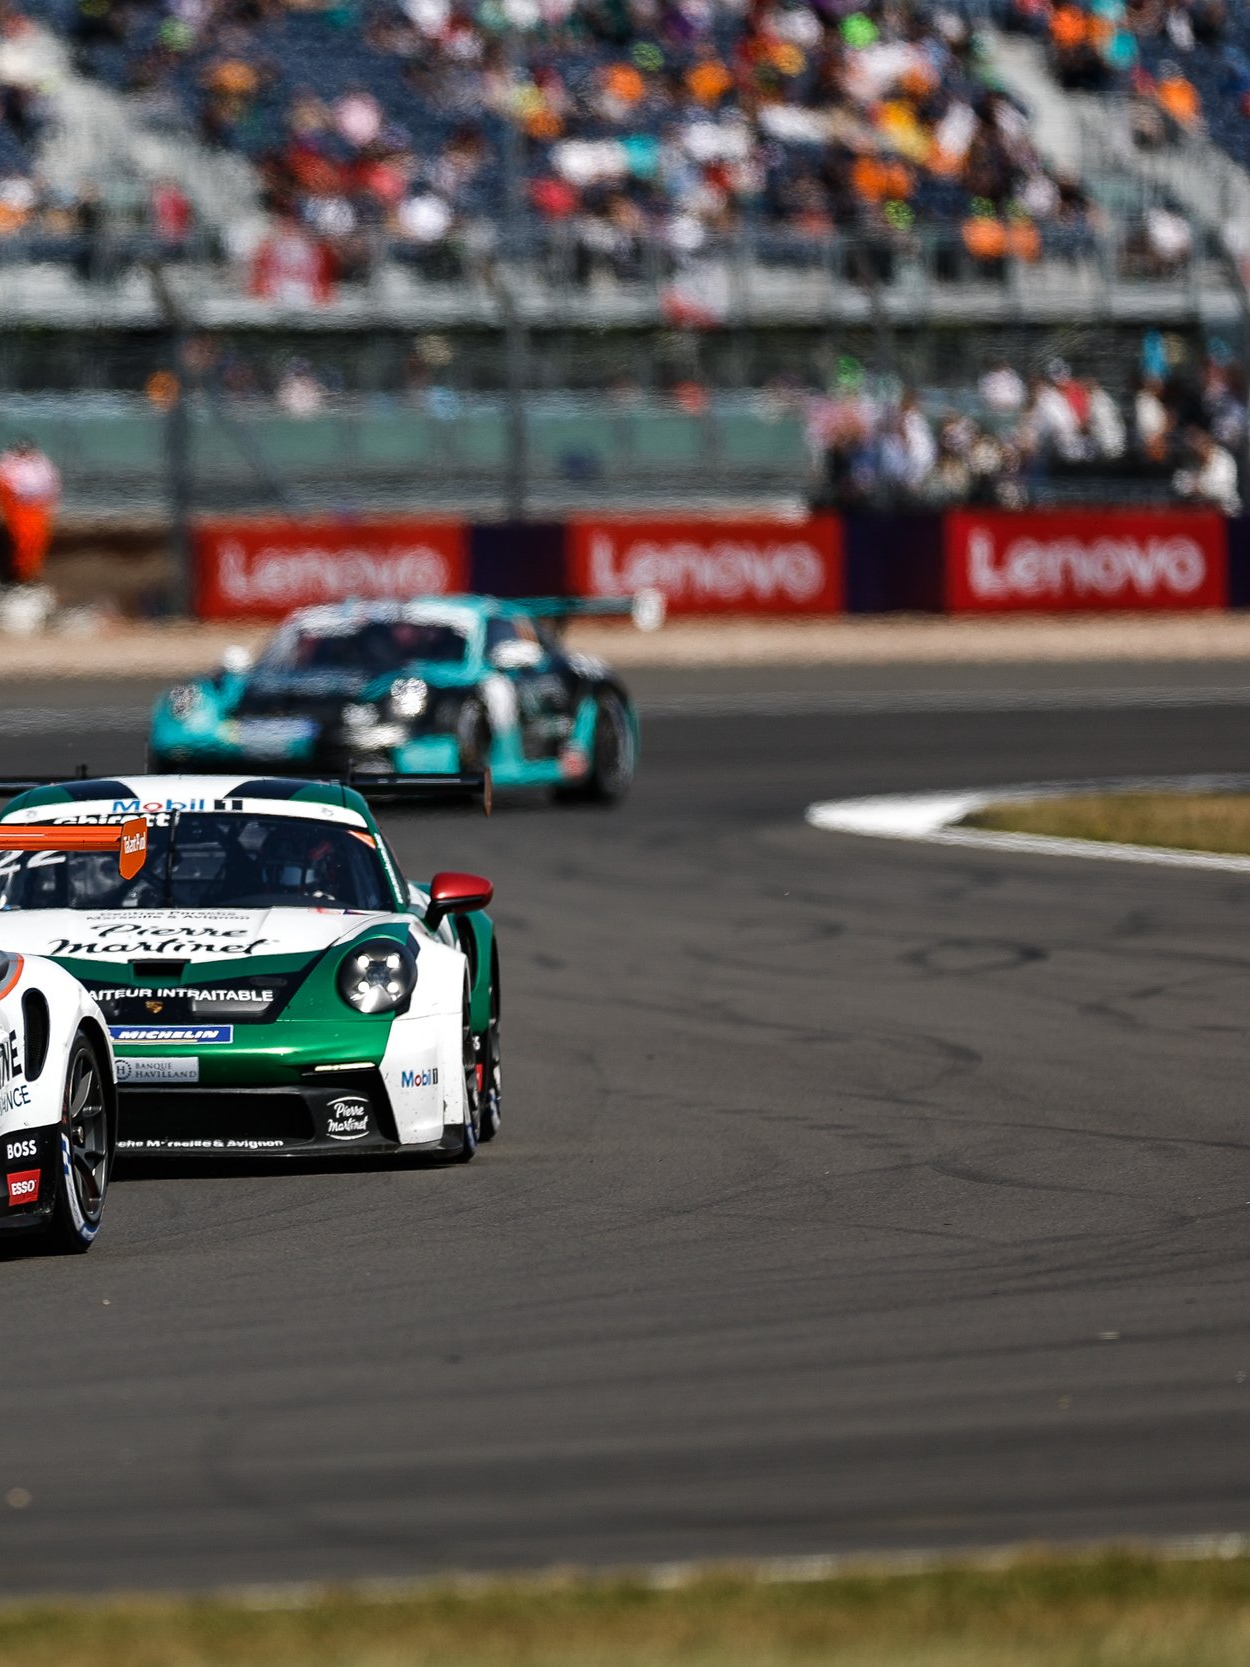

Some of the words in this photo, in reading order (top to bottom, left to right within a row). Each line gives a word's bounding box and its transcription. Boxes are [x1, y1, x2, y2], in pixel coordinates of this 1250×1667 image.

[217, 538, 448, 603] Lenovo
[589, 531, 825, 601] Lenovo
[967, 526, 1206, 599] Lenovo
[112, 800, 205, 812] Mobil
[217, 799, 241, 811] 1
[91, 923, 248, 937] Pierre
[89, 987, 153, 1001] AITEUR
[157, 987, 274, 1002] INTRAITABLE
[118, 1029, 219, 1040] MICHELIN
[135, 1062, 172, 1071] BANQUE
[135, 1070, 197, 1079] HAVILLAND
[401, 1069, 431, 1088] Mobil
[333, 1102, 365, 1118] Pierre
[327, 1115, 370, 1132] Martinet
[6, 1139, 37, 1160] BOSS
[226, 1139, 285, 1150] Avignon
[11, 1180, 36, 1196] ESSO
